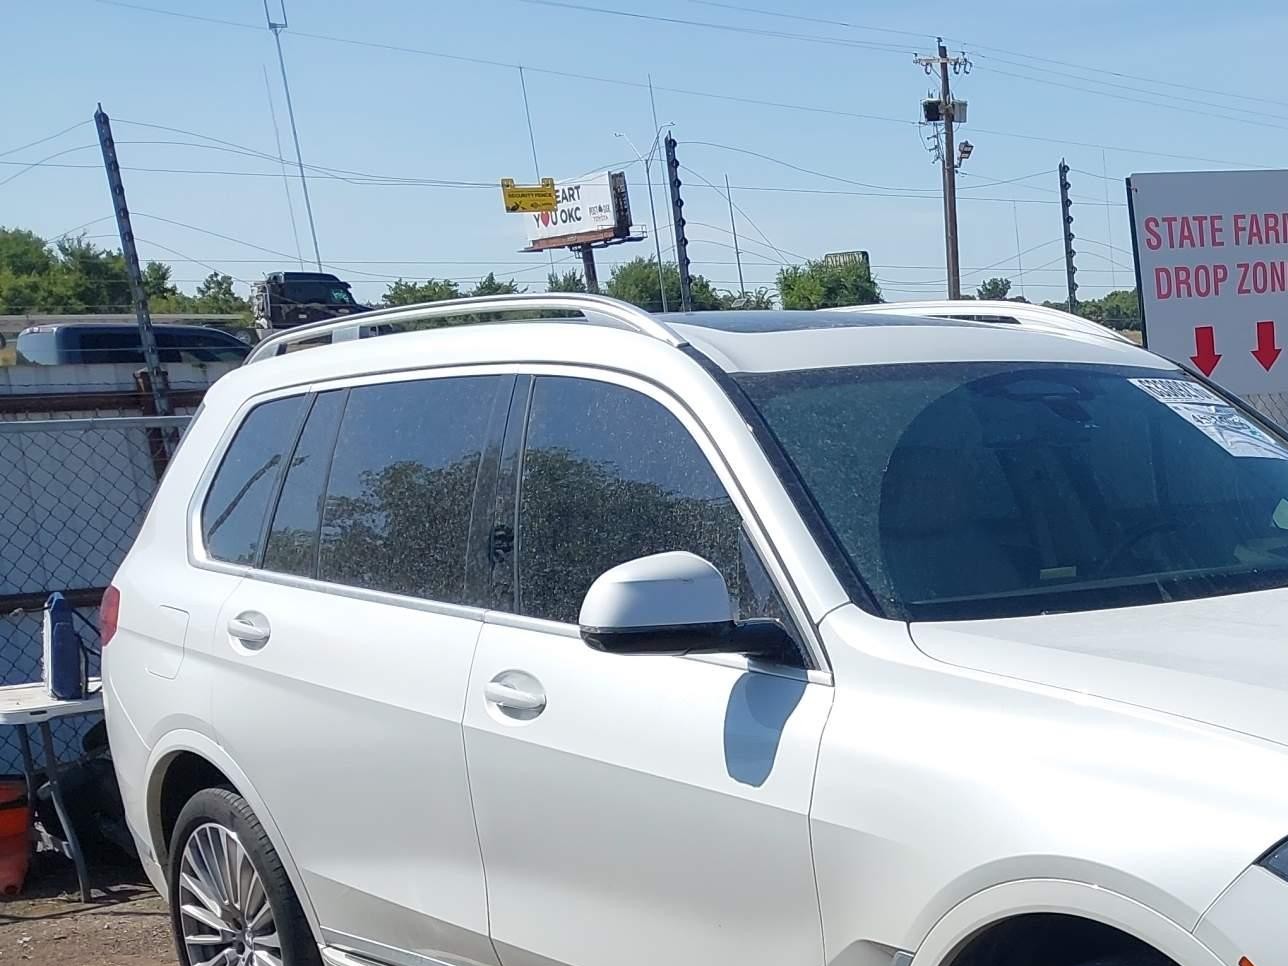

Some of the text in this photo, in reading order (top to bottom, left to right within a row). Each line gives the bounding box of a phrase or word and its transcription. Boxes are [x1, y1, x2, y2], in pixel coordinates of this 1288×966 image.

[554, 185, 581, 204] EART
[560, 207, 582, 224] OKC
[1144, 214, 1225, 250] STATE
[1154, 263, 1228, 300] DROP
